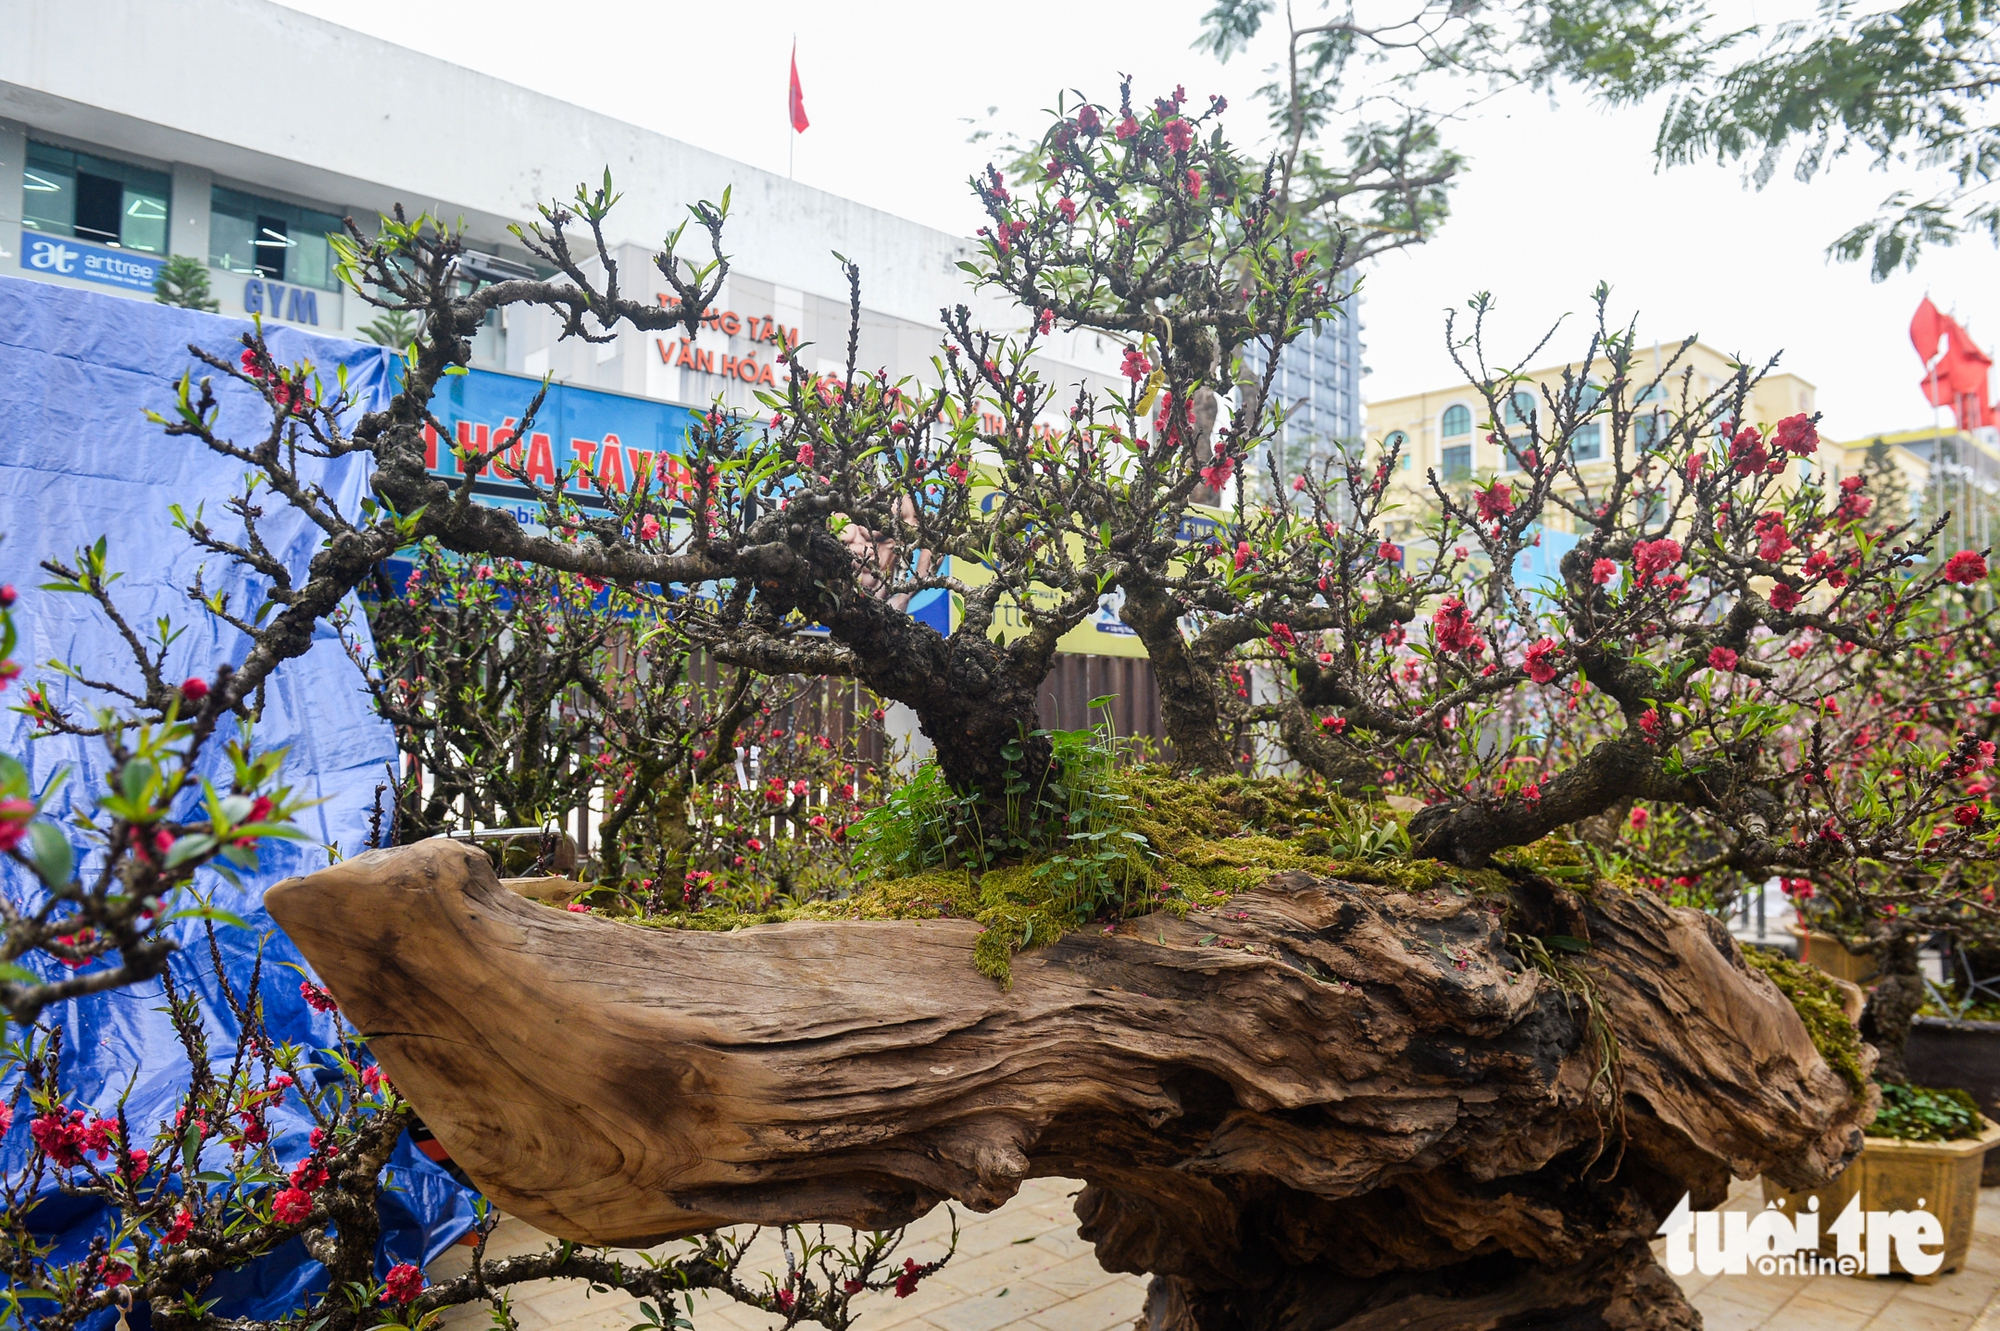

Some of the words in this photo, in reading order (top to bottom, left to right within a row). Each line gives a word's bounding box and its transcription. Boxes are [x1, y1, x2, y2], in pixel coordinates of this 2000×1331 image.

[84, 254, 154, 280] arttree
[244, 278, 319, 327] GYM
[748, 314, 798, 349] TÂM
[656, 337, 714, 375] VĂN
[721, 351, 776, 388] HÓA
[456, 417, 555, 486] HÓA
[571, 433, 655, 494] TÂY
